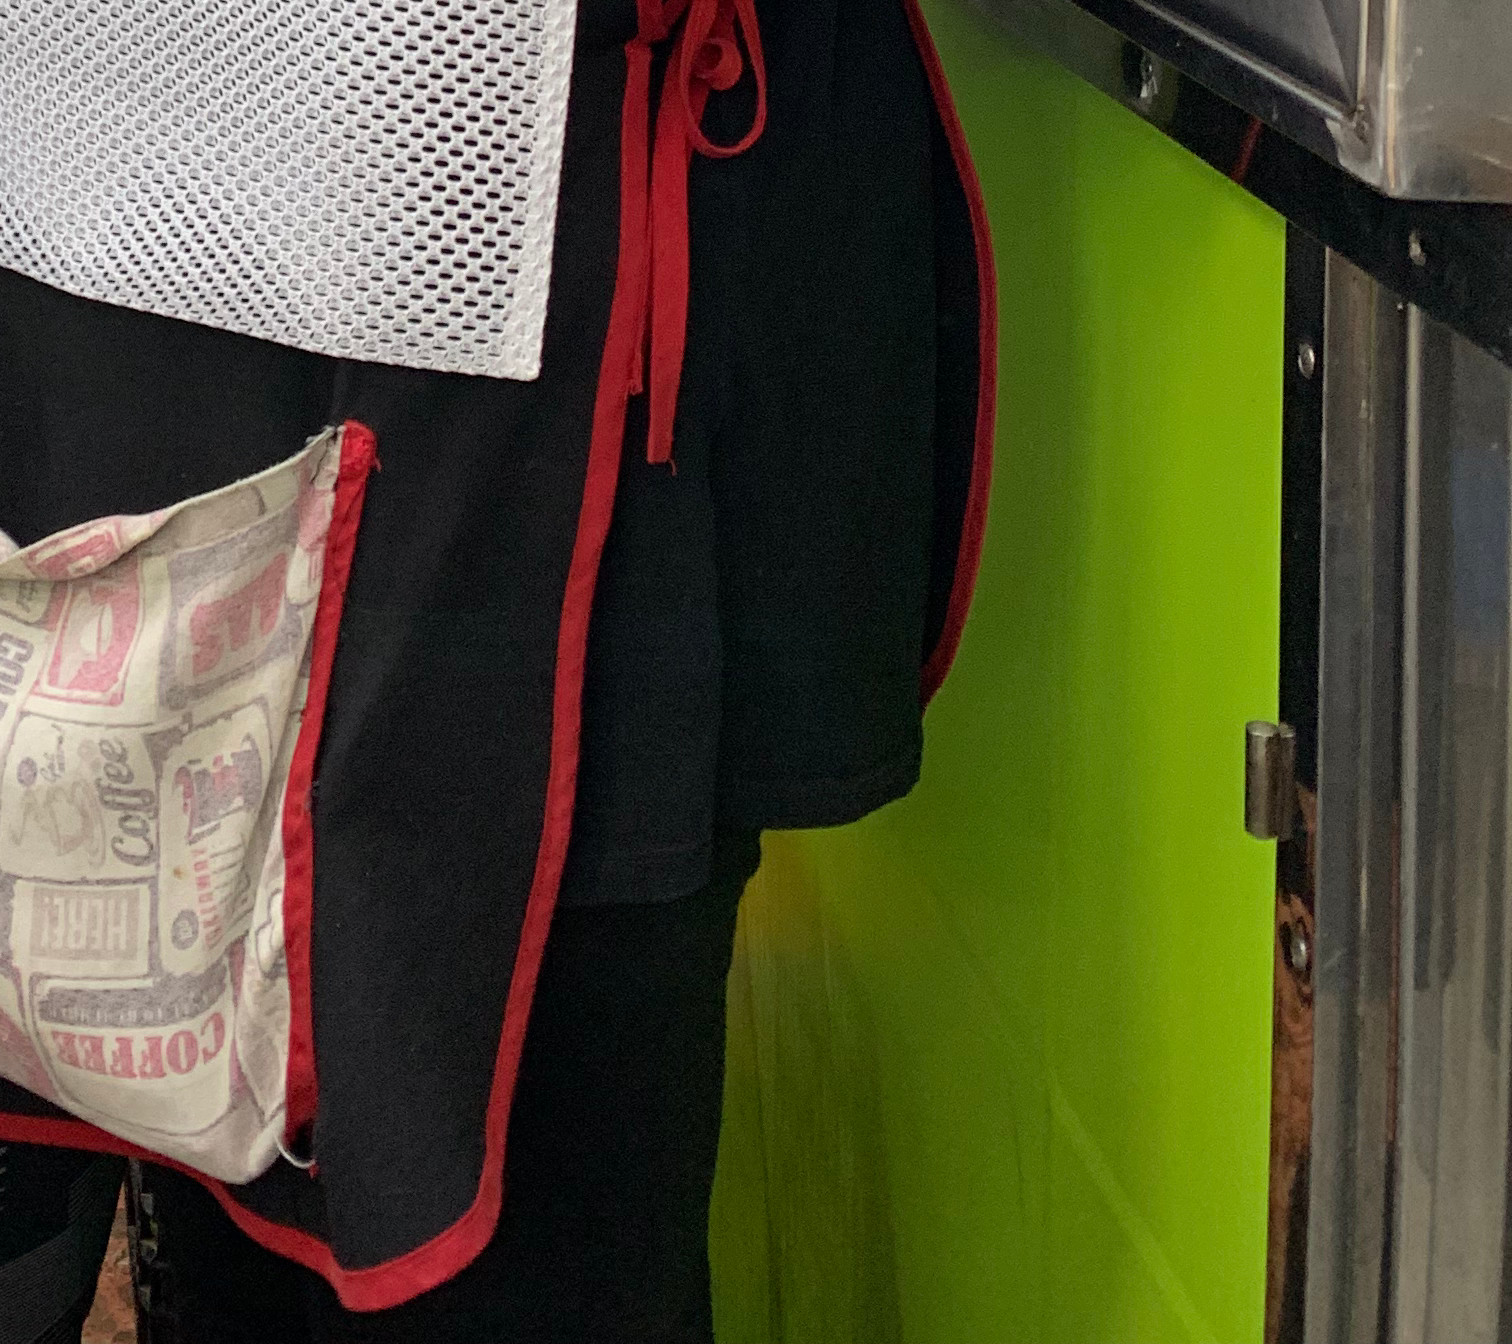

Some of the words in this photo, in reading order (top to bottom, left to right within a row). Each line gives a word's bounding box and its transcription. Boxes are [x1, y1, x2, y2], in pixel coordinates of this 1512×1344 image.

[97, 736, 158, 868] Coffee
[40, 892, 130, 952] HERE!
[52, 1011, 227, 1079] COFFEE
